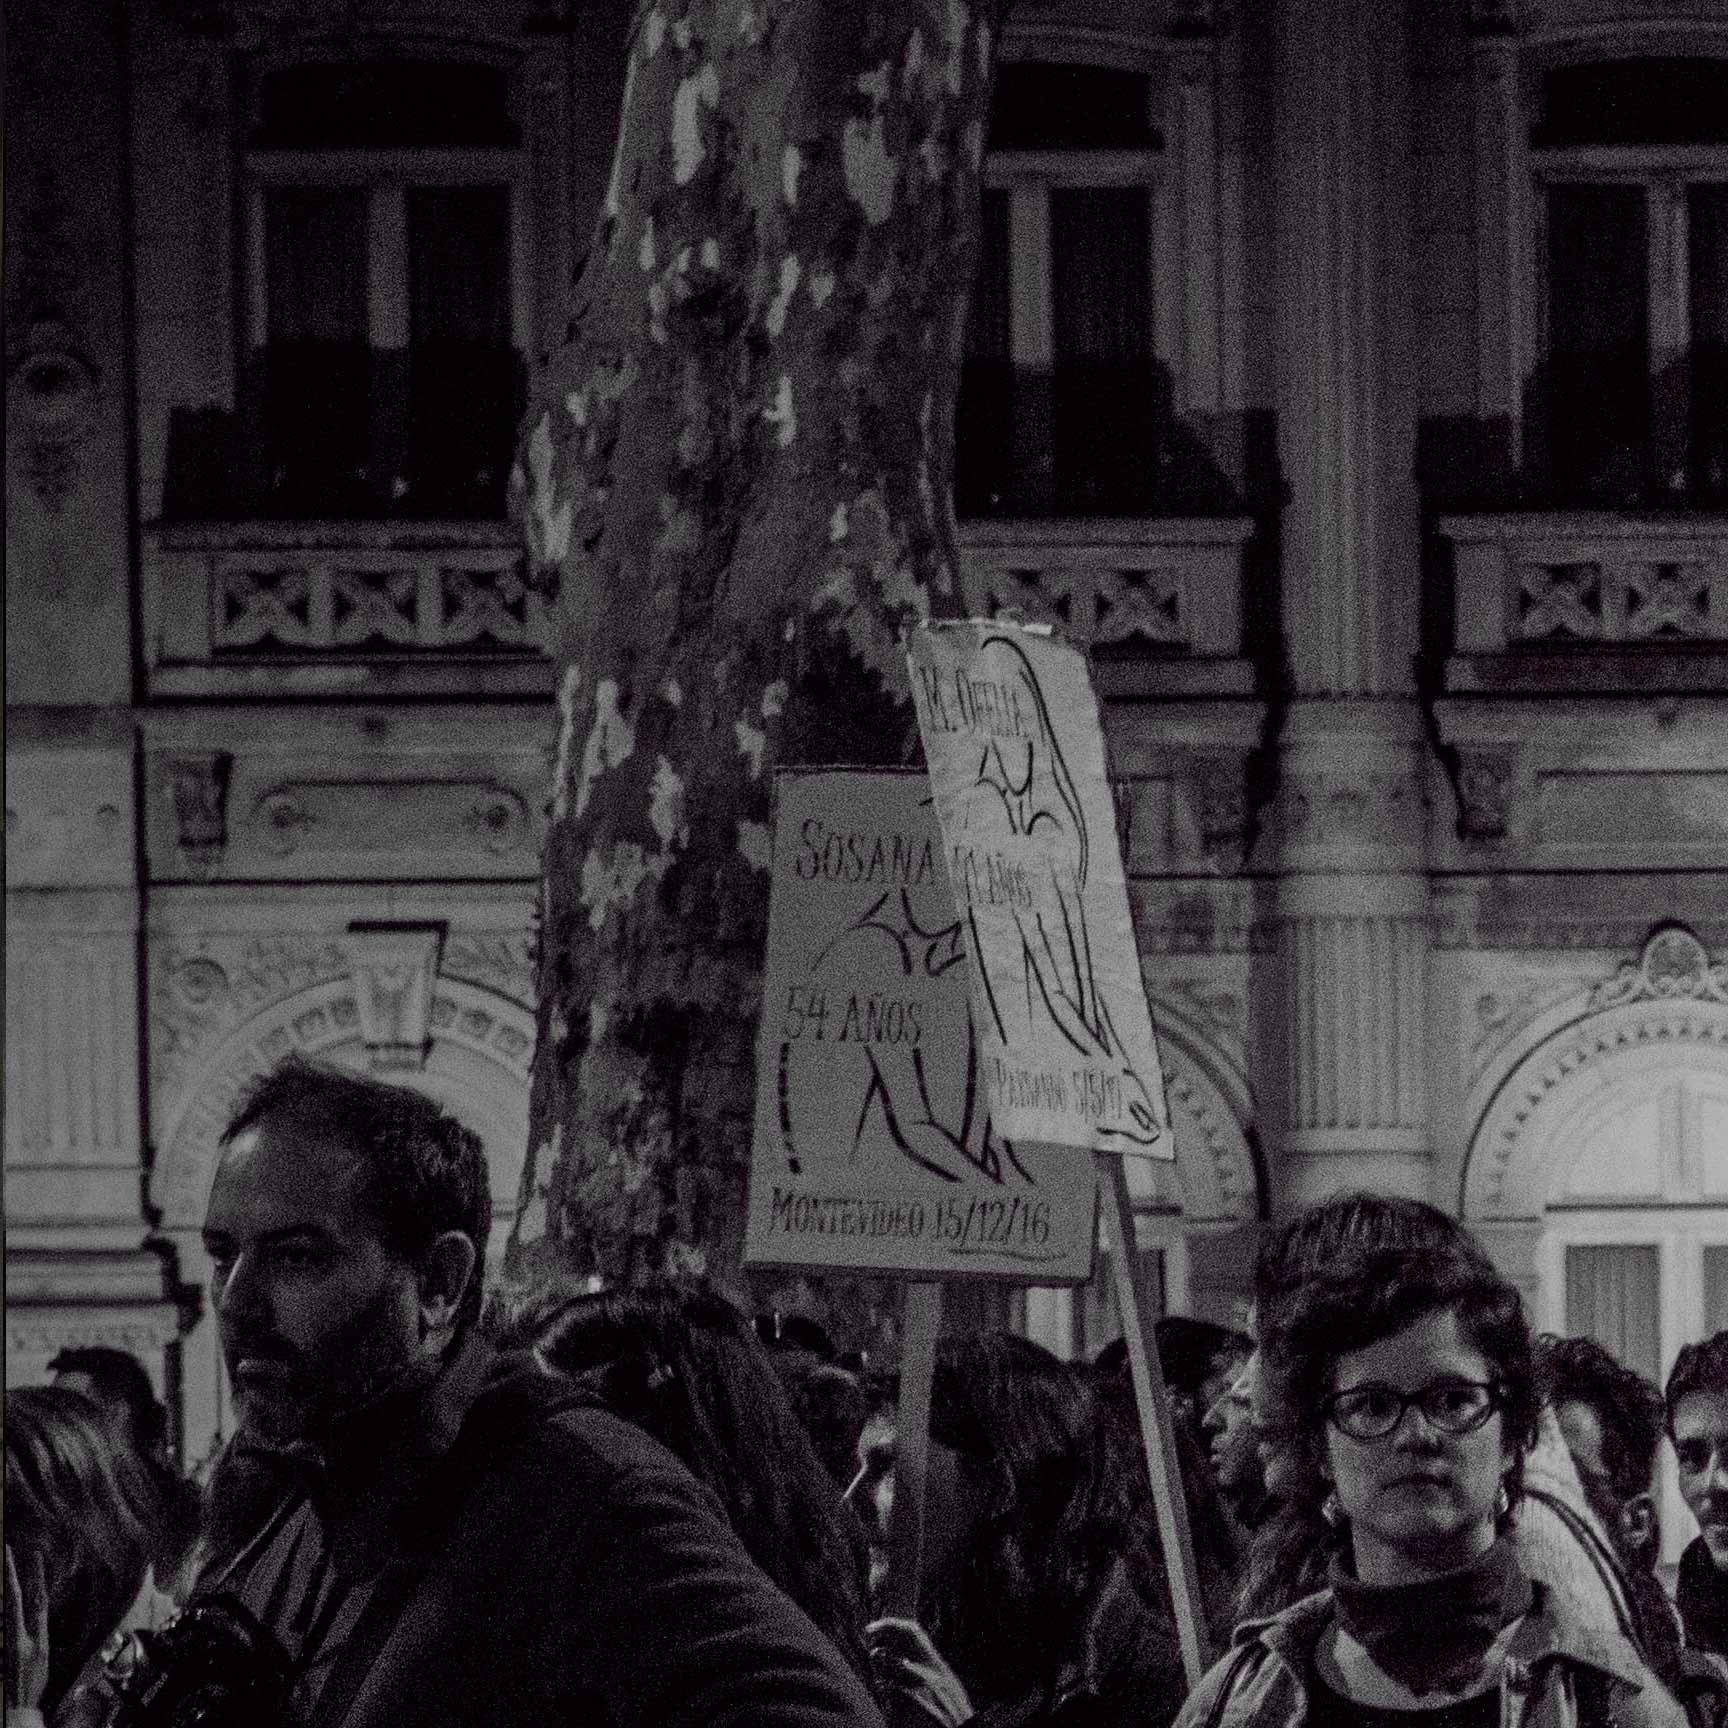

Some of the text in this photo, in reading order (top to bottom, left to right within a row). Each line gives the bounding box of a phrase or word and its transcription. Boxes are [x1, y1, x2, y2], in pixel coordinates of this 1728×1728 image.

[786, 984, 923, 1044] 54 AÑOS
[768, 1187, 1052, 1247] MONTEVIDEO 15/12/16
